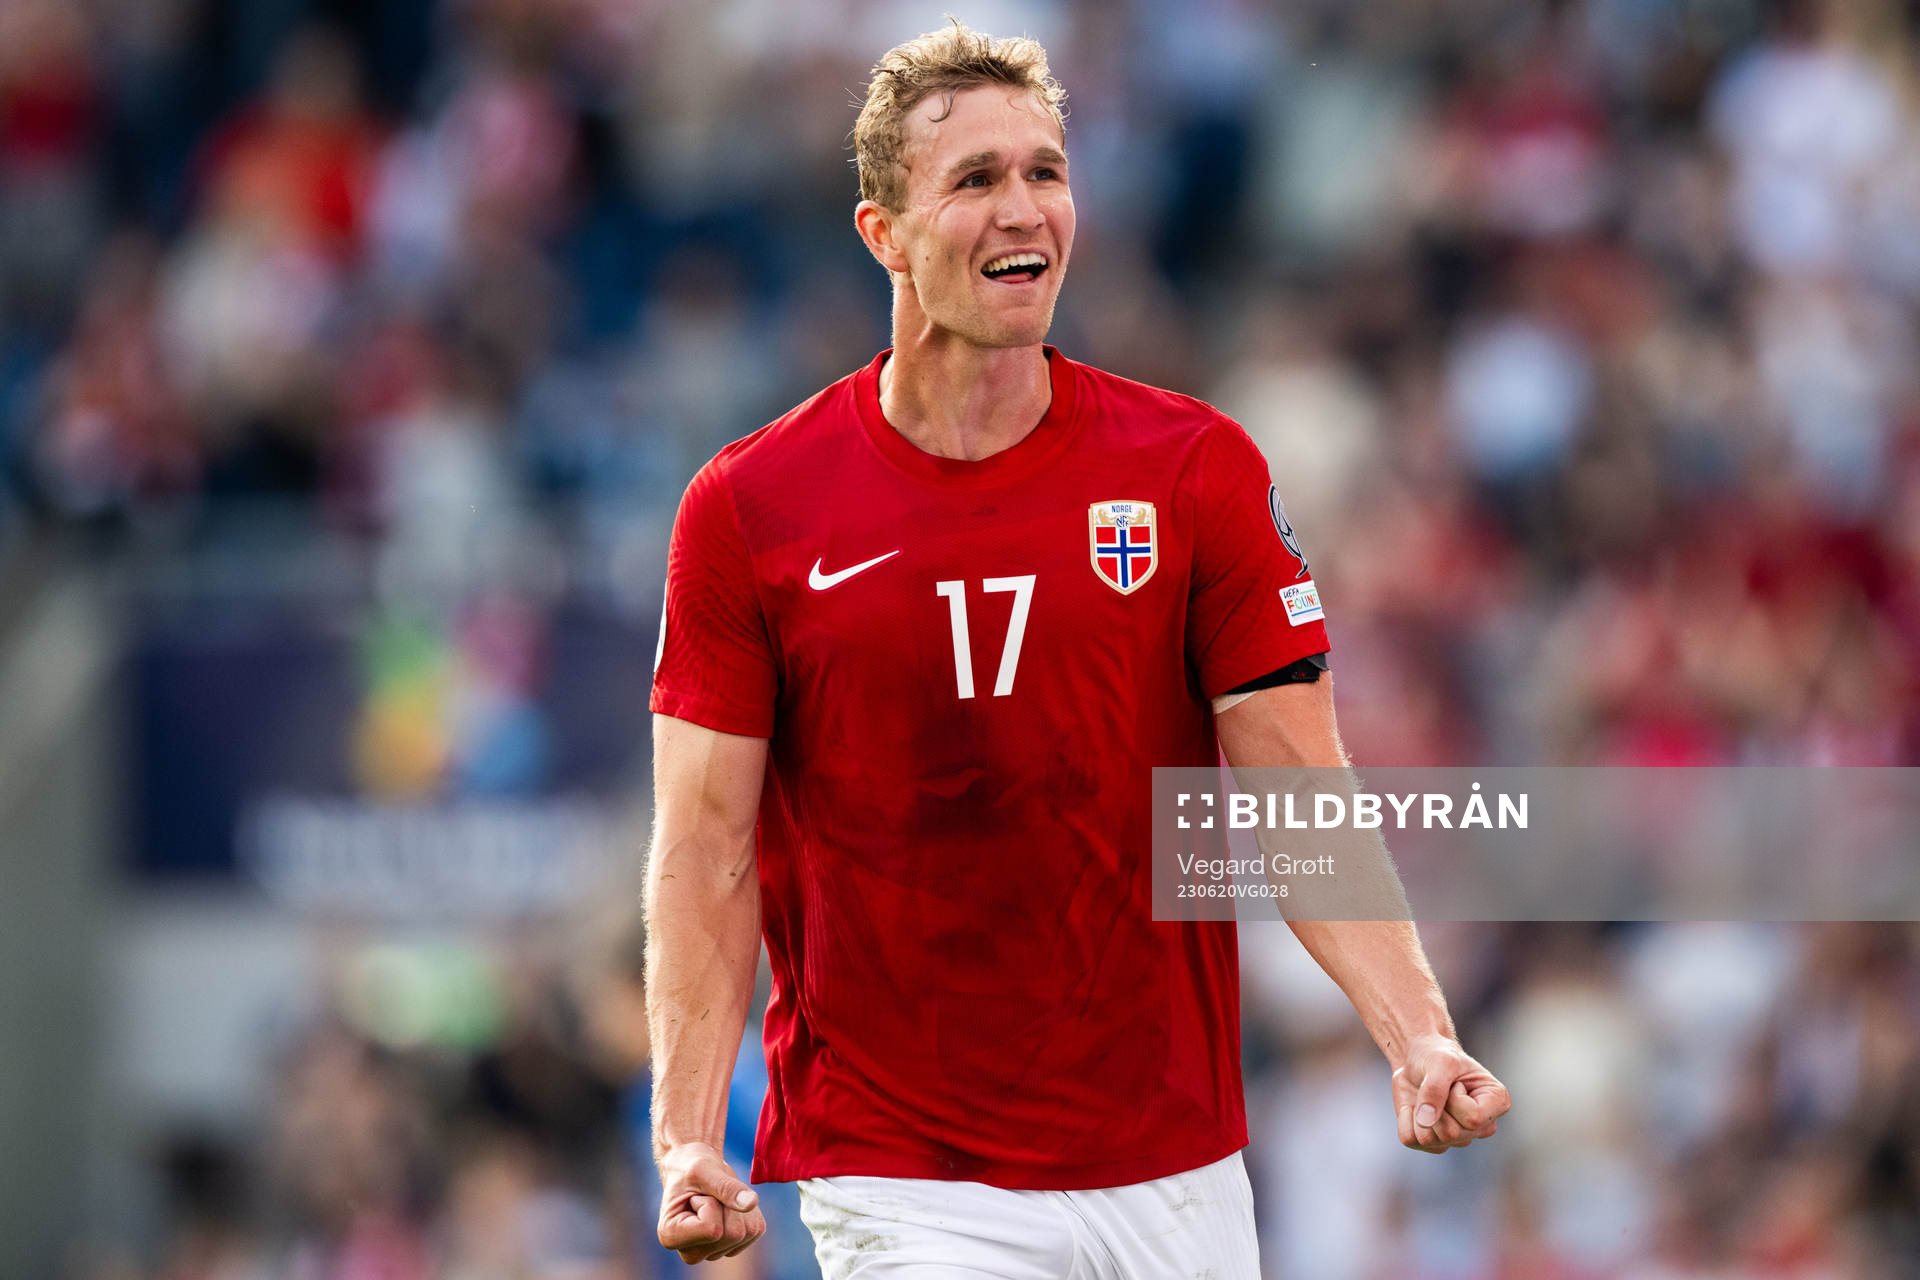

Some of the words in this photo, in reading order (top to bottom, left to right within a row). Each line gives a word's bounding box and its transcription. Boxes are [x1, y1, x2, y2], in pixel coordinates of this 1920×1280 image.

[1111, 505, 1133, 513] NORGE
[1283, 587, 1300, 599] UEFA
[936, 574, 1037, 700] 17
